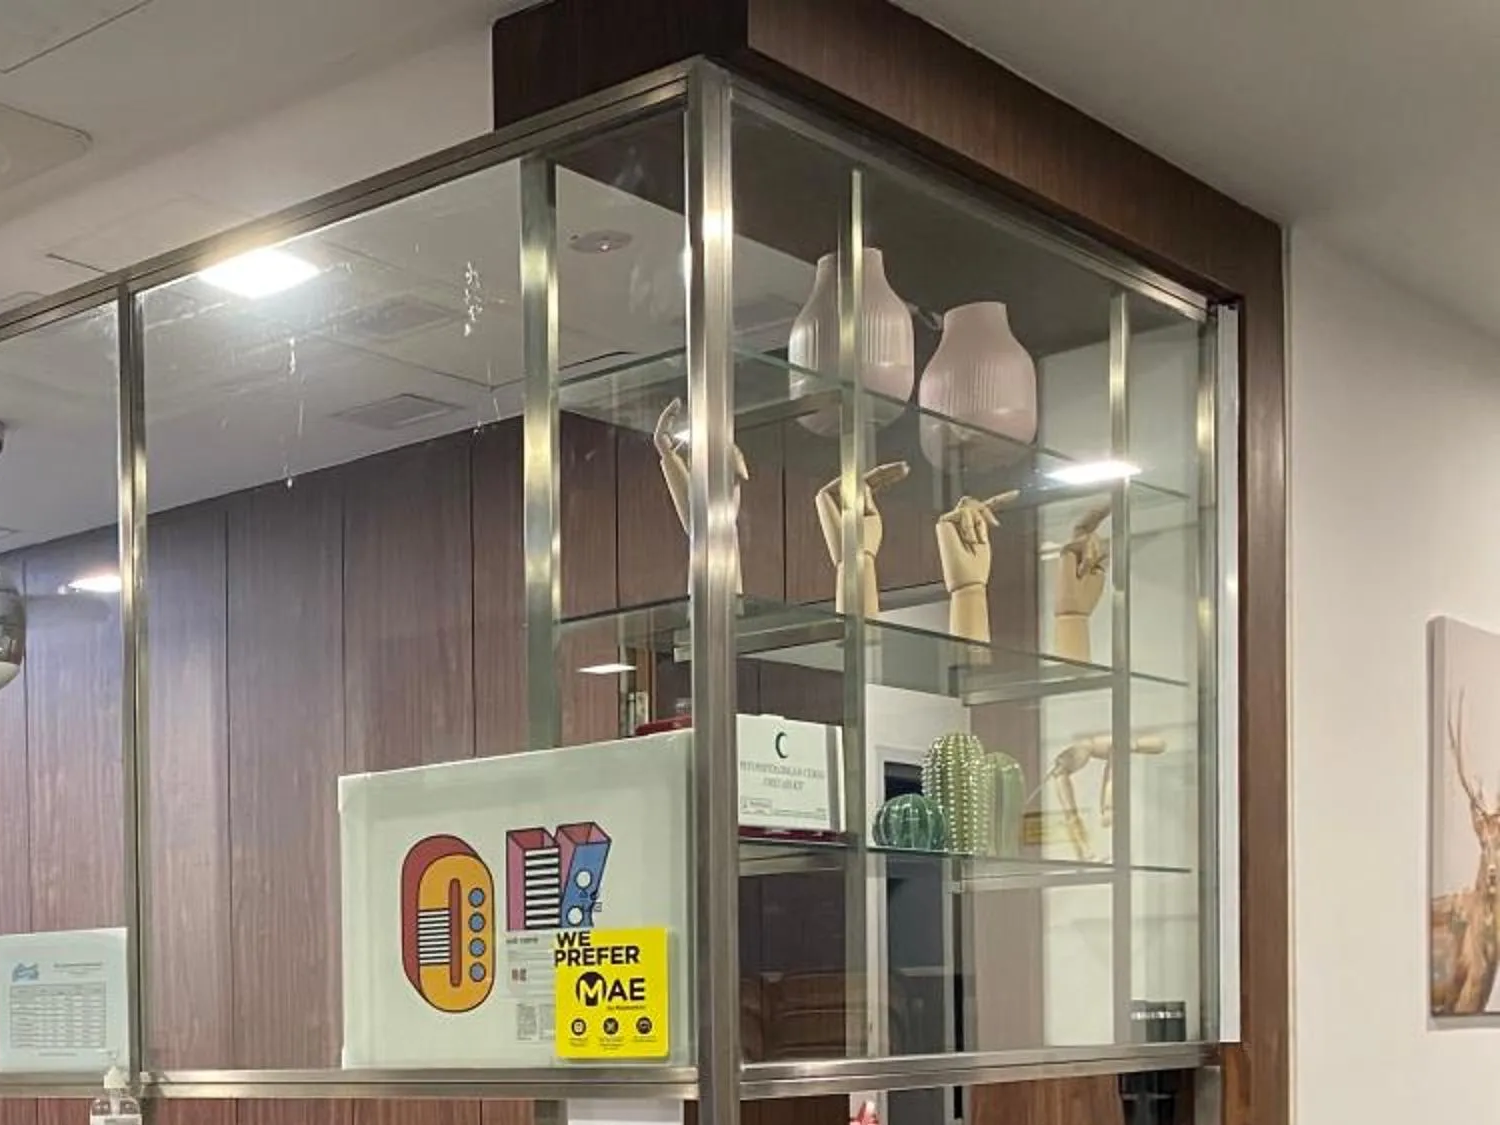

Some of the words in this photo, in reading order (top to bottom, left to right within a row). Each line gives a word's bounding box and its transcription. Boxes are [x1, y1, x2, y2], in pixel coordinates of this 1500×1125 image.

[557, 931, 591, 948] WE
[554, 945, 640, 967] PREFER
[576, 972, 645, 1006] MAE
